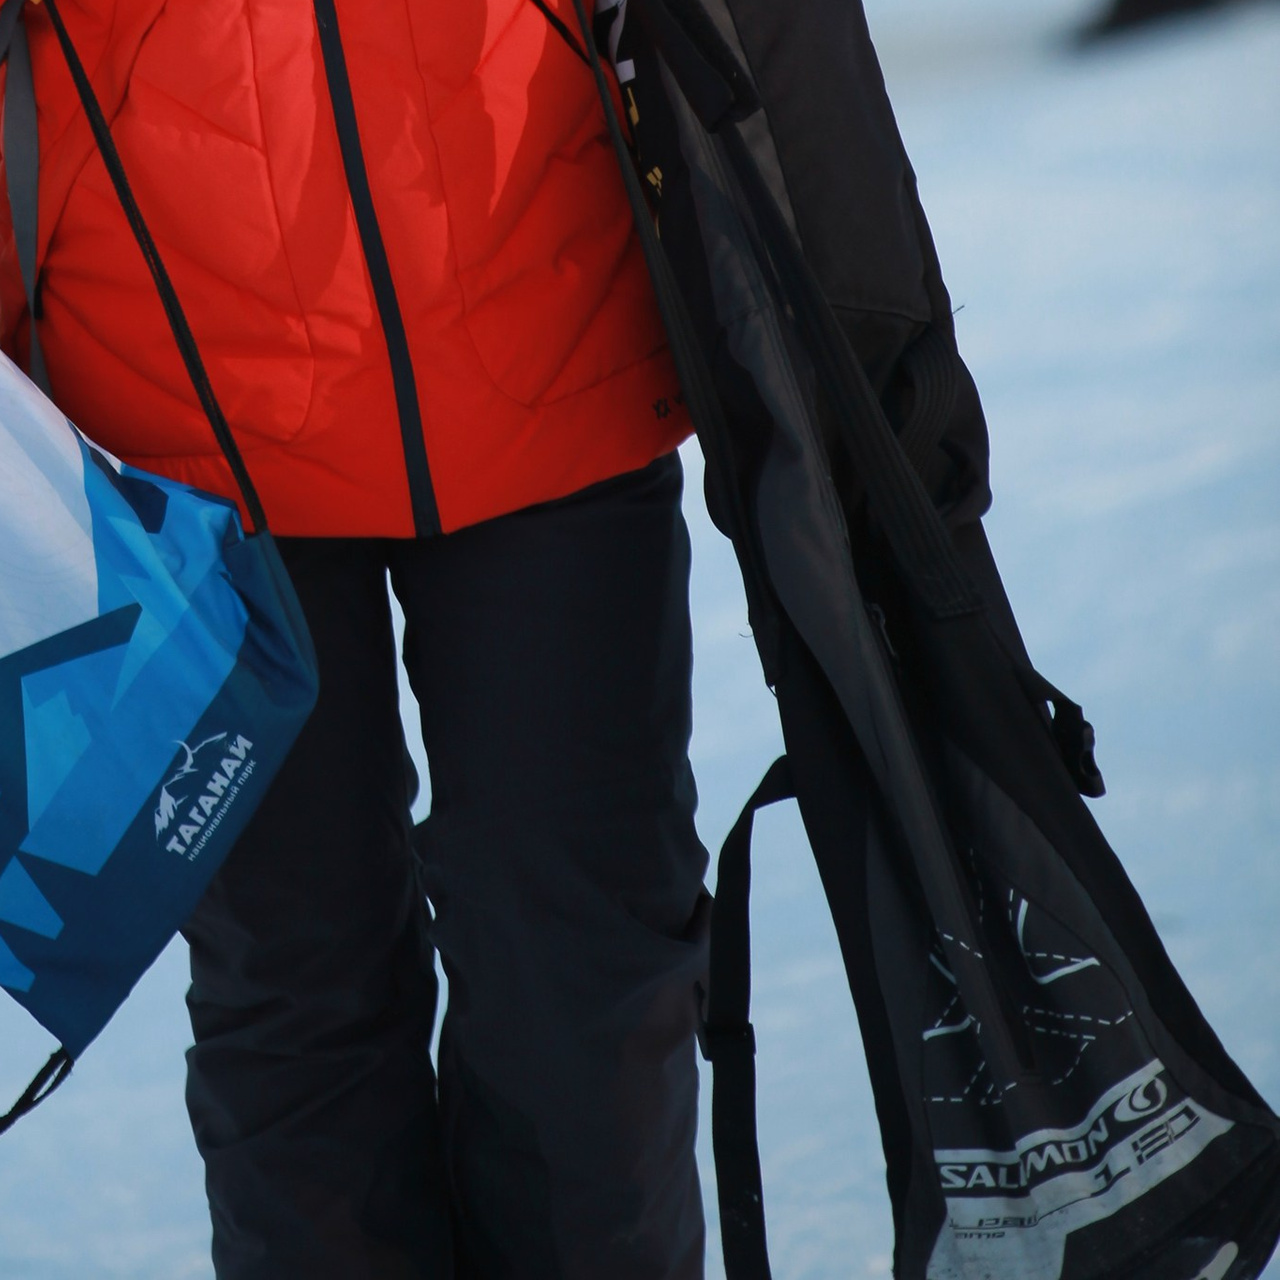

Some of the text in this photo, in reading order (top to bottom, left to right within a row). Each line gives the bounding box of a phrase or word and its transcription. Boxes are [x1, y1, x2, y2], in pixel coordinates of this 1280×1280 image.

[166, 734, 254, 855] ТАГАНАЙ
[187, 759, 257, 862] национальный парк
